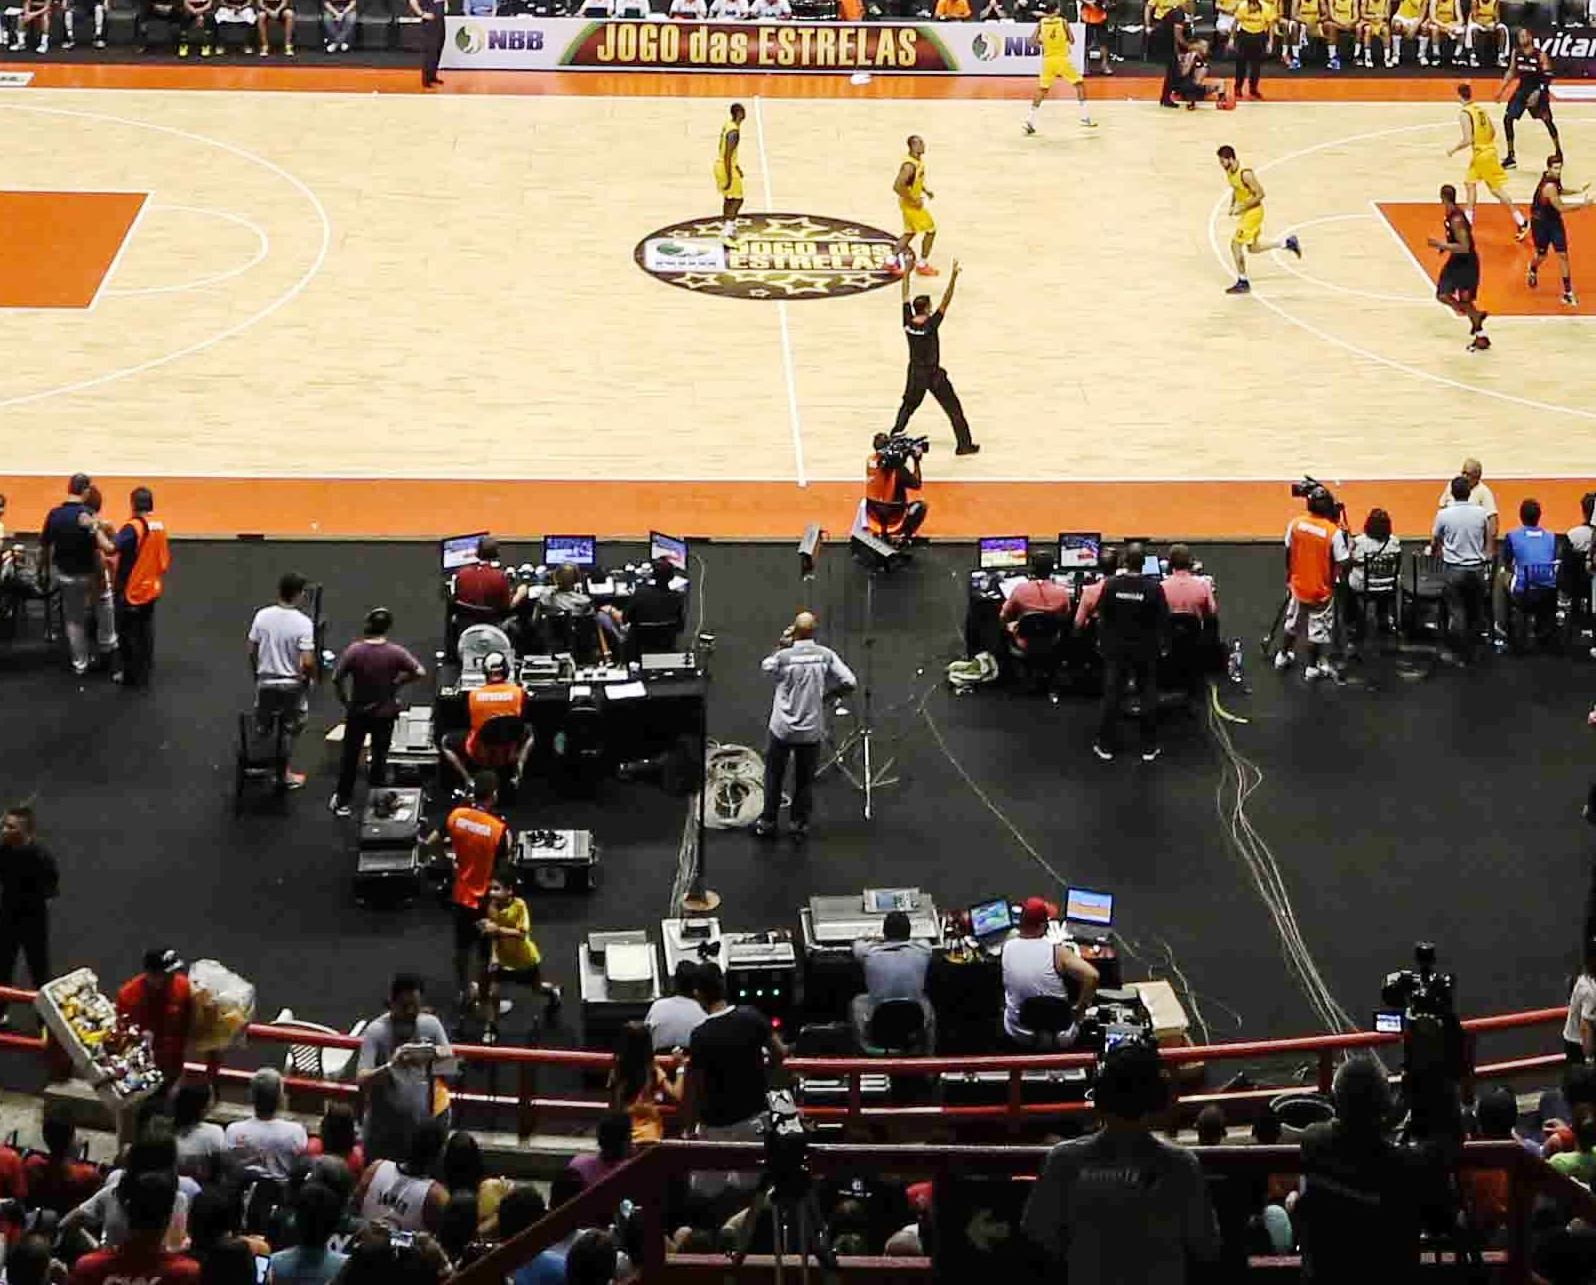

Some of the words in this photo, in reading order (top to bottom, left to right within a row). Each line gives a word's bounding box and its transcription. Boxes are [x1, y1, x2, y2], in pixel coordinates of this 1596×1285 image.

[488, 29, 545, 51] NBB
[597, 23, 680, 63] JOGO
[689, 25, 749, 64] das
[758, 26, 918, 67] ESTRELAS
[1004, 36, 1042, 57] NB
